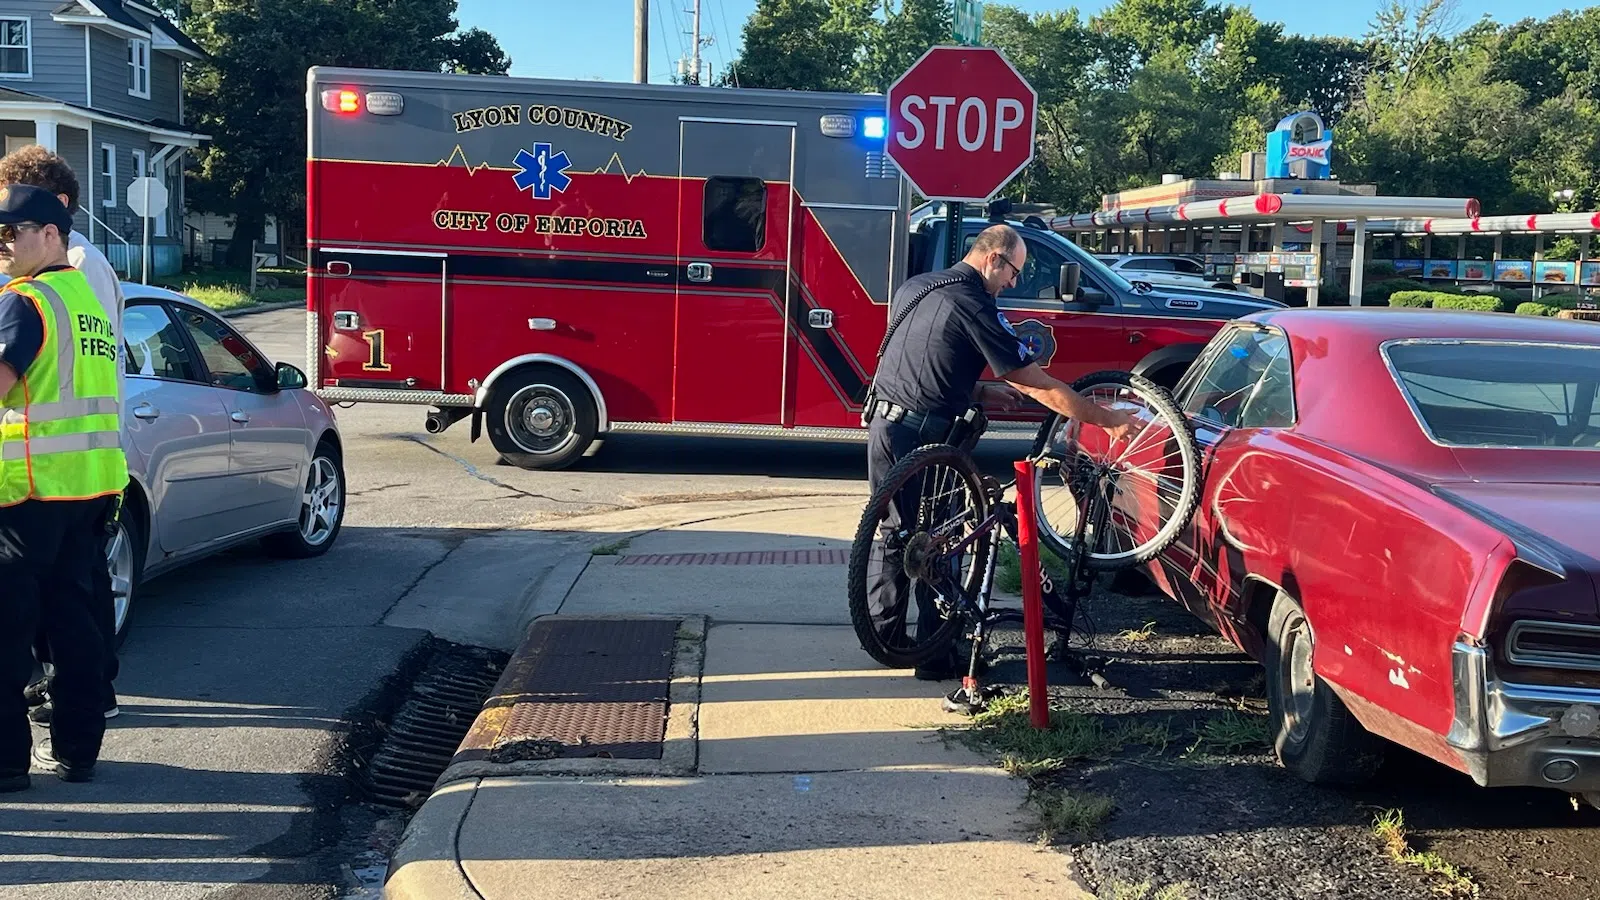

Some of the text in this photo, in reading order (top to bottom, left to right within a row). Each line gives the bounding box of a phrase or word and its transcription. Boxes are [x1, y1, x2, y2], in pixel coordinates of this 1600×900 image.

[452, 104, 632, 141] LYON COUNTY
[896, 94, 1025, 153] STOP
[1289, 147, 1325, 158] SONIC
[433, 209, 646, 239] CITY OF EMPORIA
[362, 329, 392, 372] 1
